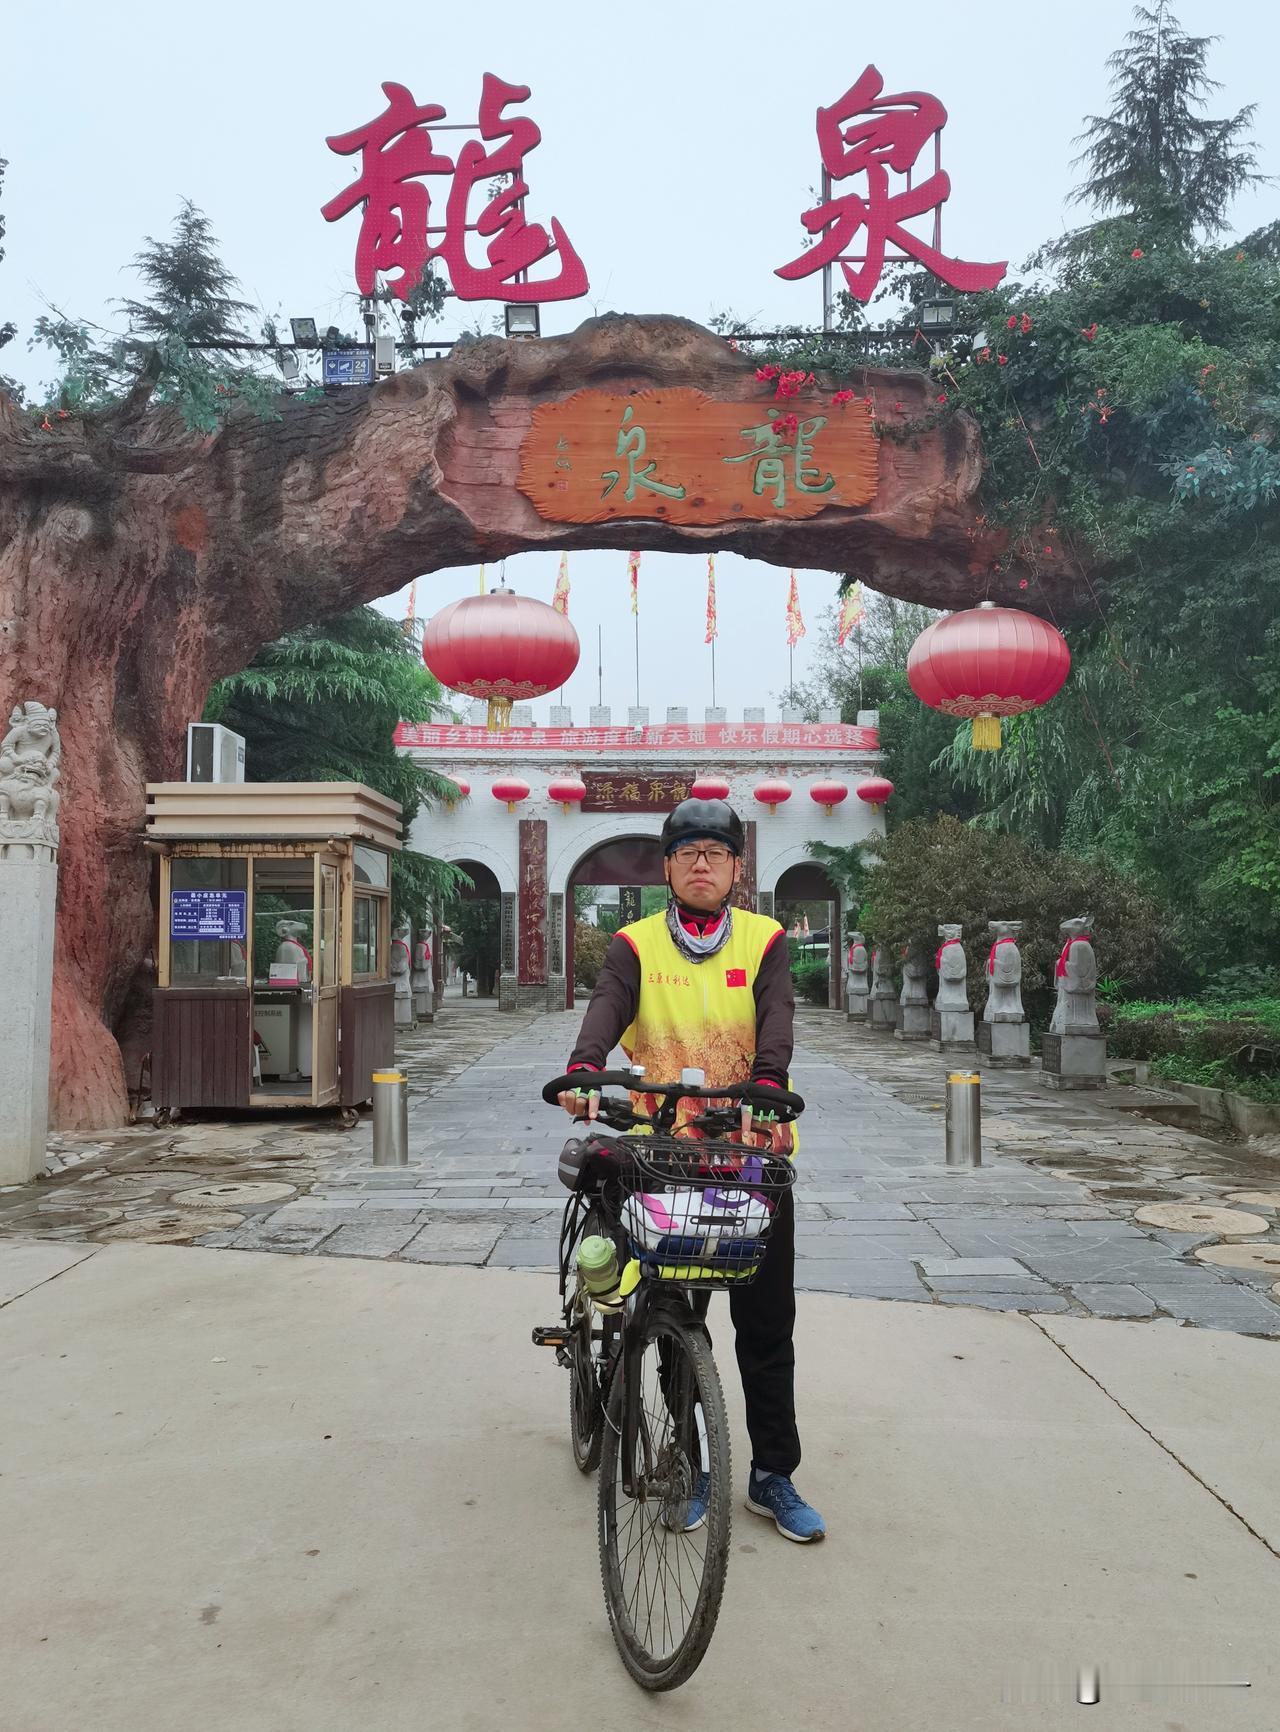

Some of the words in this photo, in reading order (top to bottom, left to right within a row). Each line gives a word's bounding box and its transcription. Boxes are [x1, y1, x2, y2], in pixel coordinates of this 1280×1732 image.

[401, 726, 547, 745] 美丽乡村新龙泉
[560, 728, 706, 746] 旅游度假新天地
[719, 726, 865, 745] 快乐假期心选择
